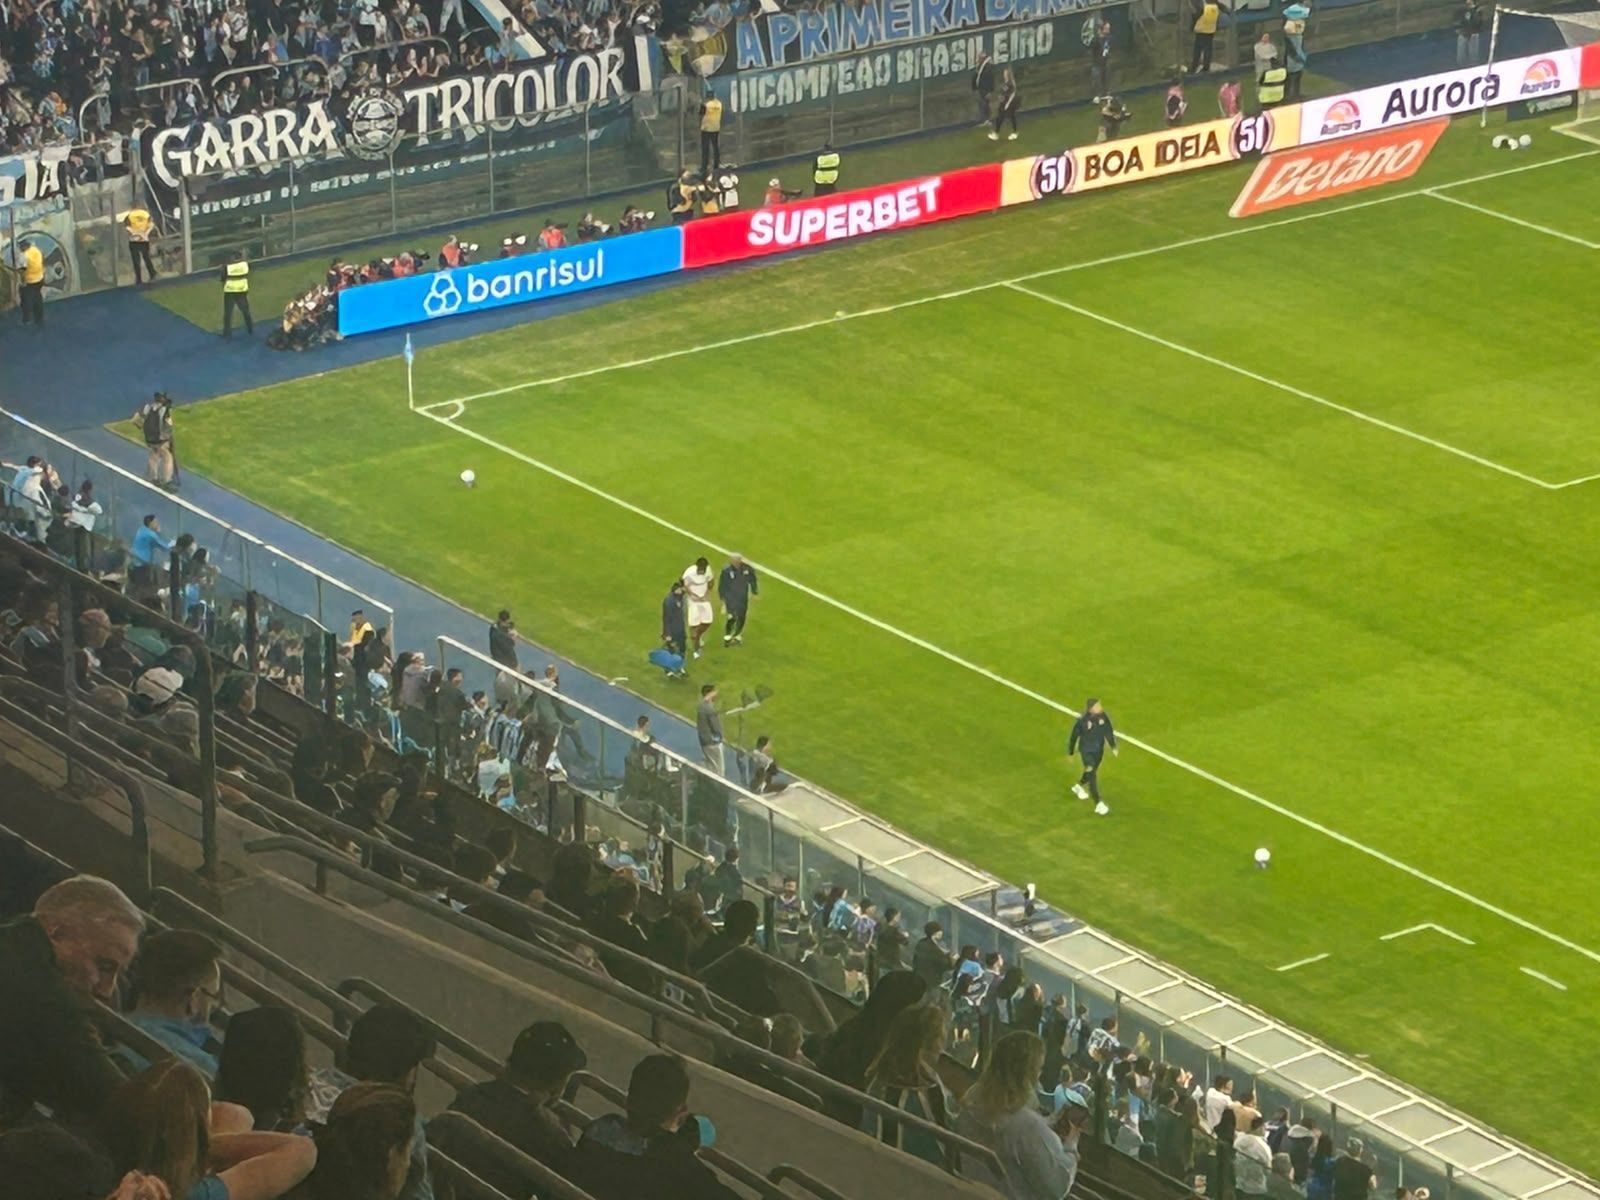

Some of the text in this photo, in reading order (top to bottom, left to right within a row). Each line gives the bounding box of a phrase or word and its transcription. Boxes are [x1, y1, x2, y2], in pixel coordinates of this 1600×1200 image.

[736, 20, 767, 69] A
[152, 100, 345, 188] GARRA
[404, 47, 627, 147] TRICOLOR
[1382, 74, 1500, 123] Aurora
[1084, 131, 1220, 181] BOA IDEIA
[1239, 116, 1264, 153] 51
[1040, 157, 1066, 193] 51
[1255, 139, 1424, 204] Betano
[747, 176, 942, 248] SUPERBET
[466, 248, 604, 304] banrisul
